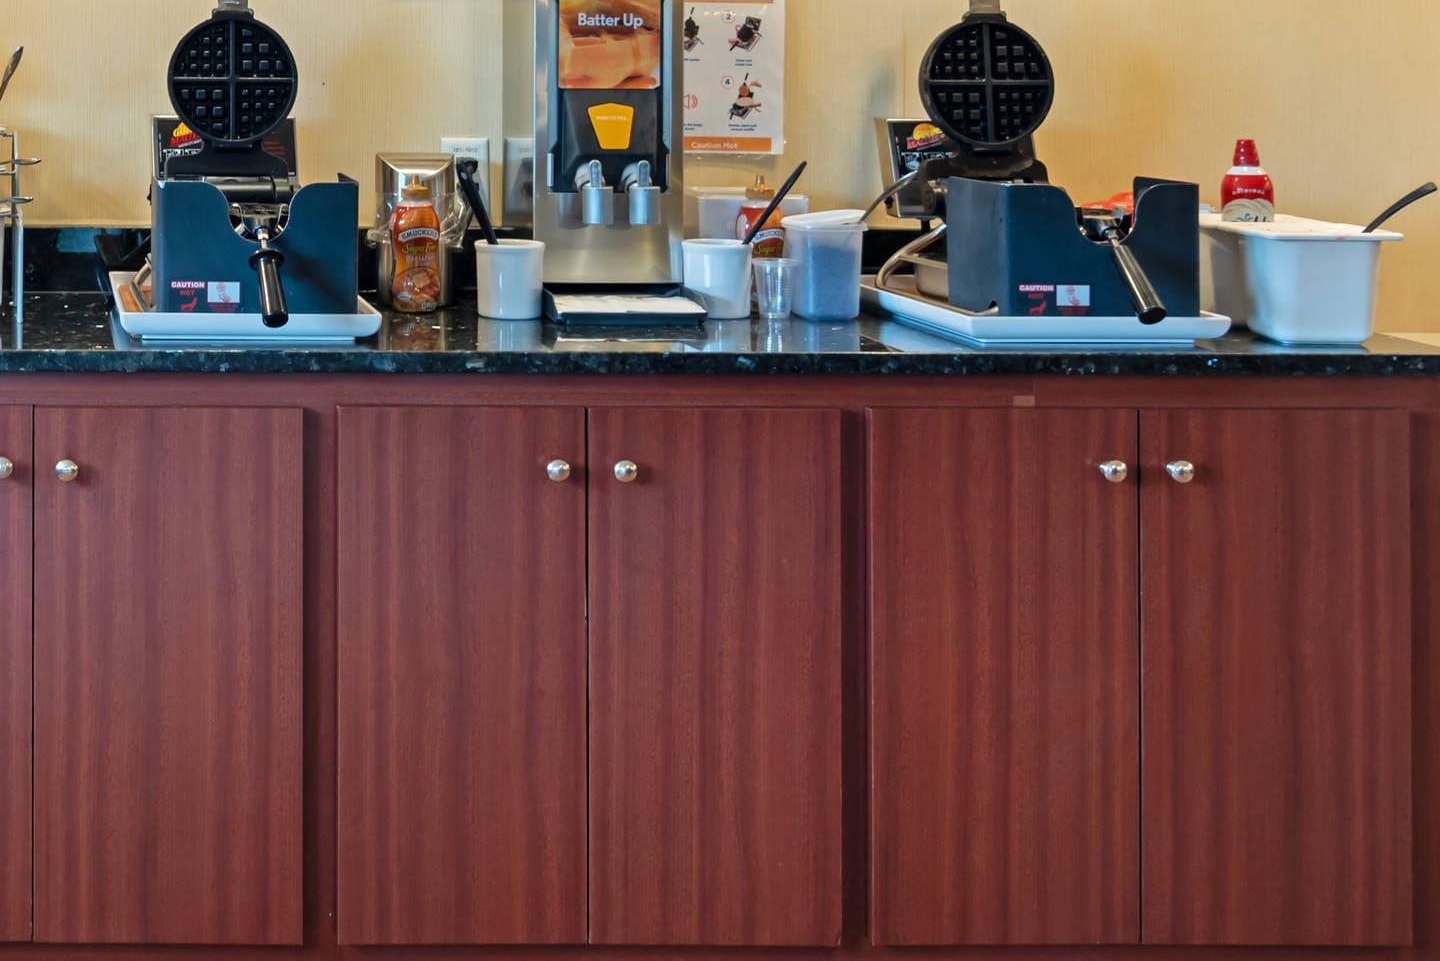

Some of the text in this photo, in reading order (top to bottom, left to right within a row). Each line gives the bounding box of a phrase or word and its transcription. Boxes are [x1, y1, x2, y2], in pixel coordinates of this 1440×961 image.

[577, 12, 643, 29] Batter Up
[691, 141, 721, 149] Caution
